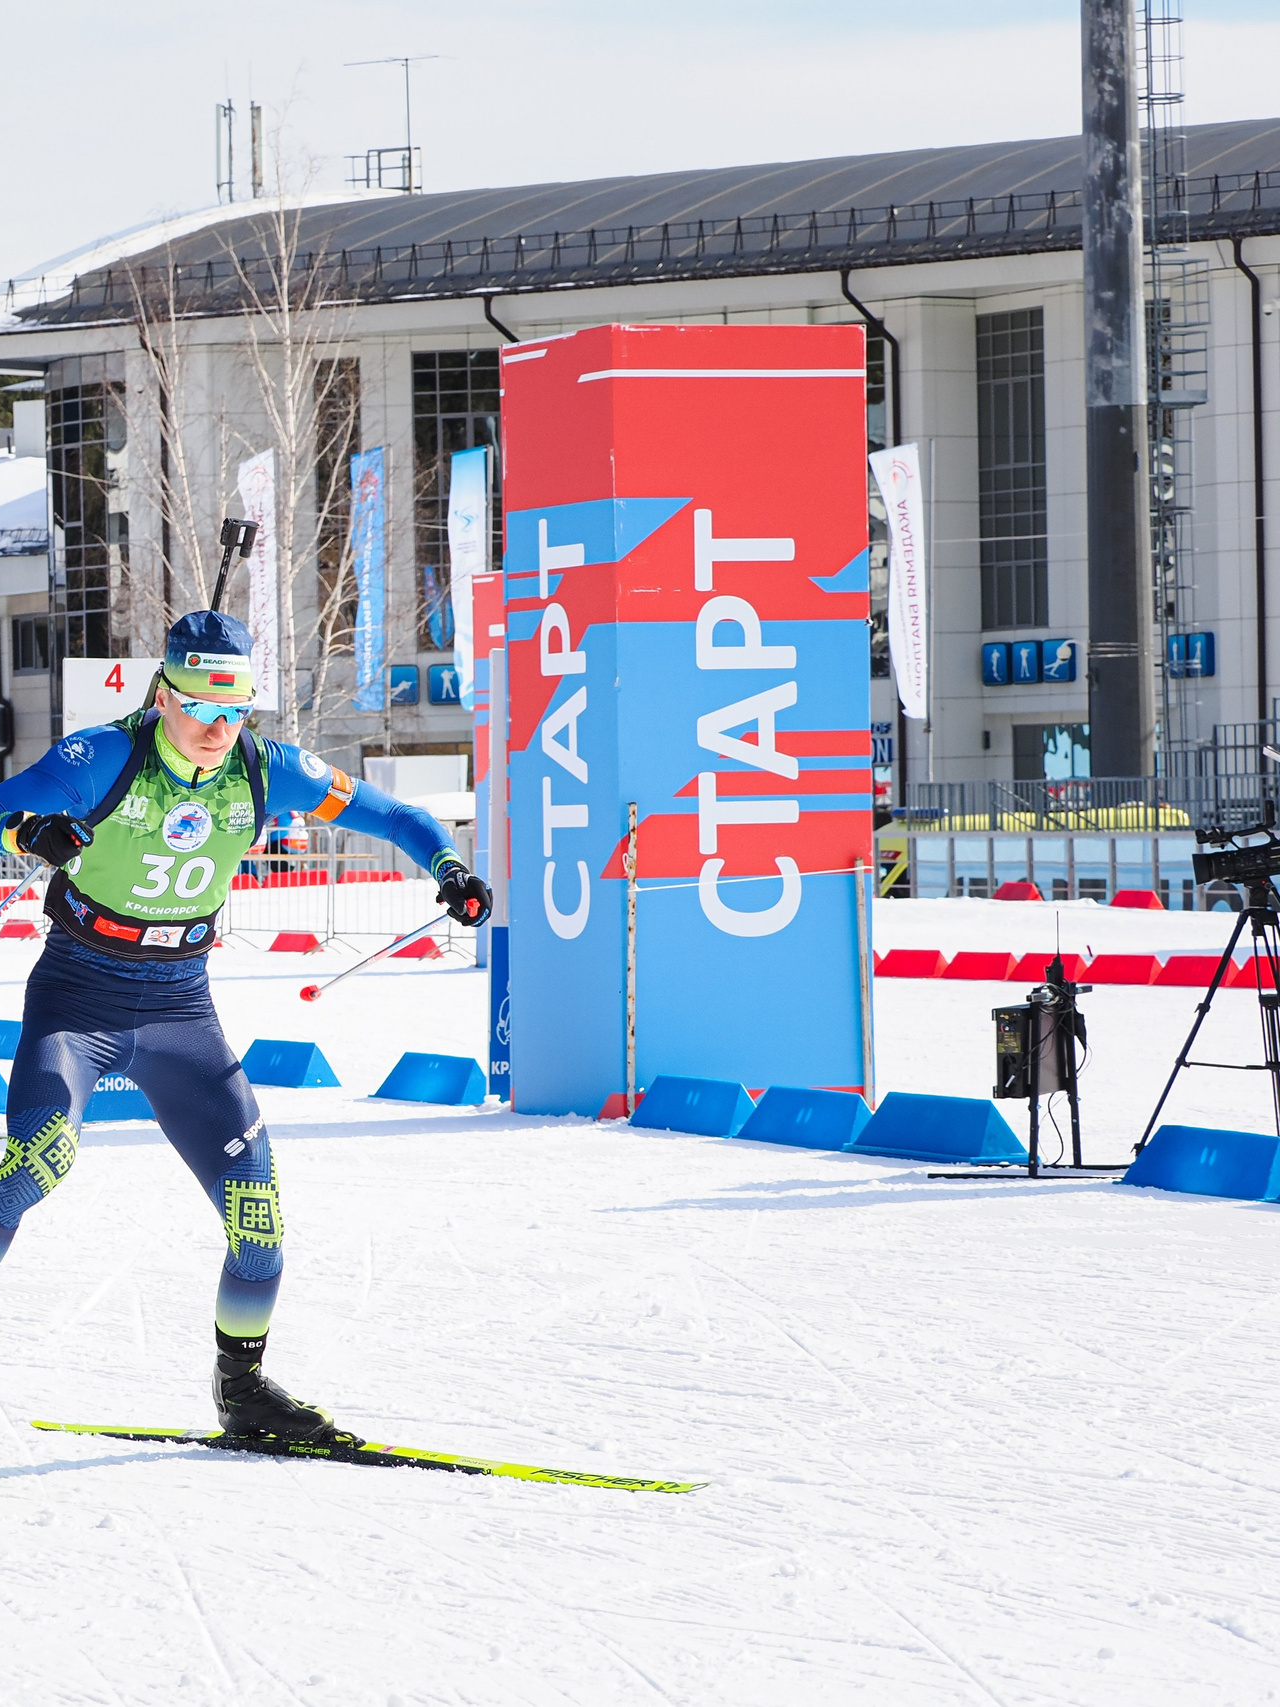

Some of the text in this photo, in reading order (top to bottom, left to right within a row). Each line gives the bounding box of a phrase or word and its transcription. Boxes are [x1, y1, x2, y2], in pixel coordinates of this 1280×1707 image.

[105, 664, 124, 693] 4
[538, 518, 592, 940] СТАРТ
[694, 508, 804, 938] СТАРТ
[130, 852, 217, 899] 30
[125, 900, 200, 916] КРАСНОЯРСК
[241, 1340, 263, 1349] 180
[289, 1445, 331, 1456] FISCHER
[530, 1467, 656, 1488] FISCHER
